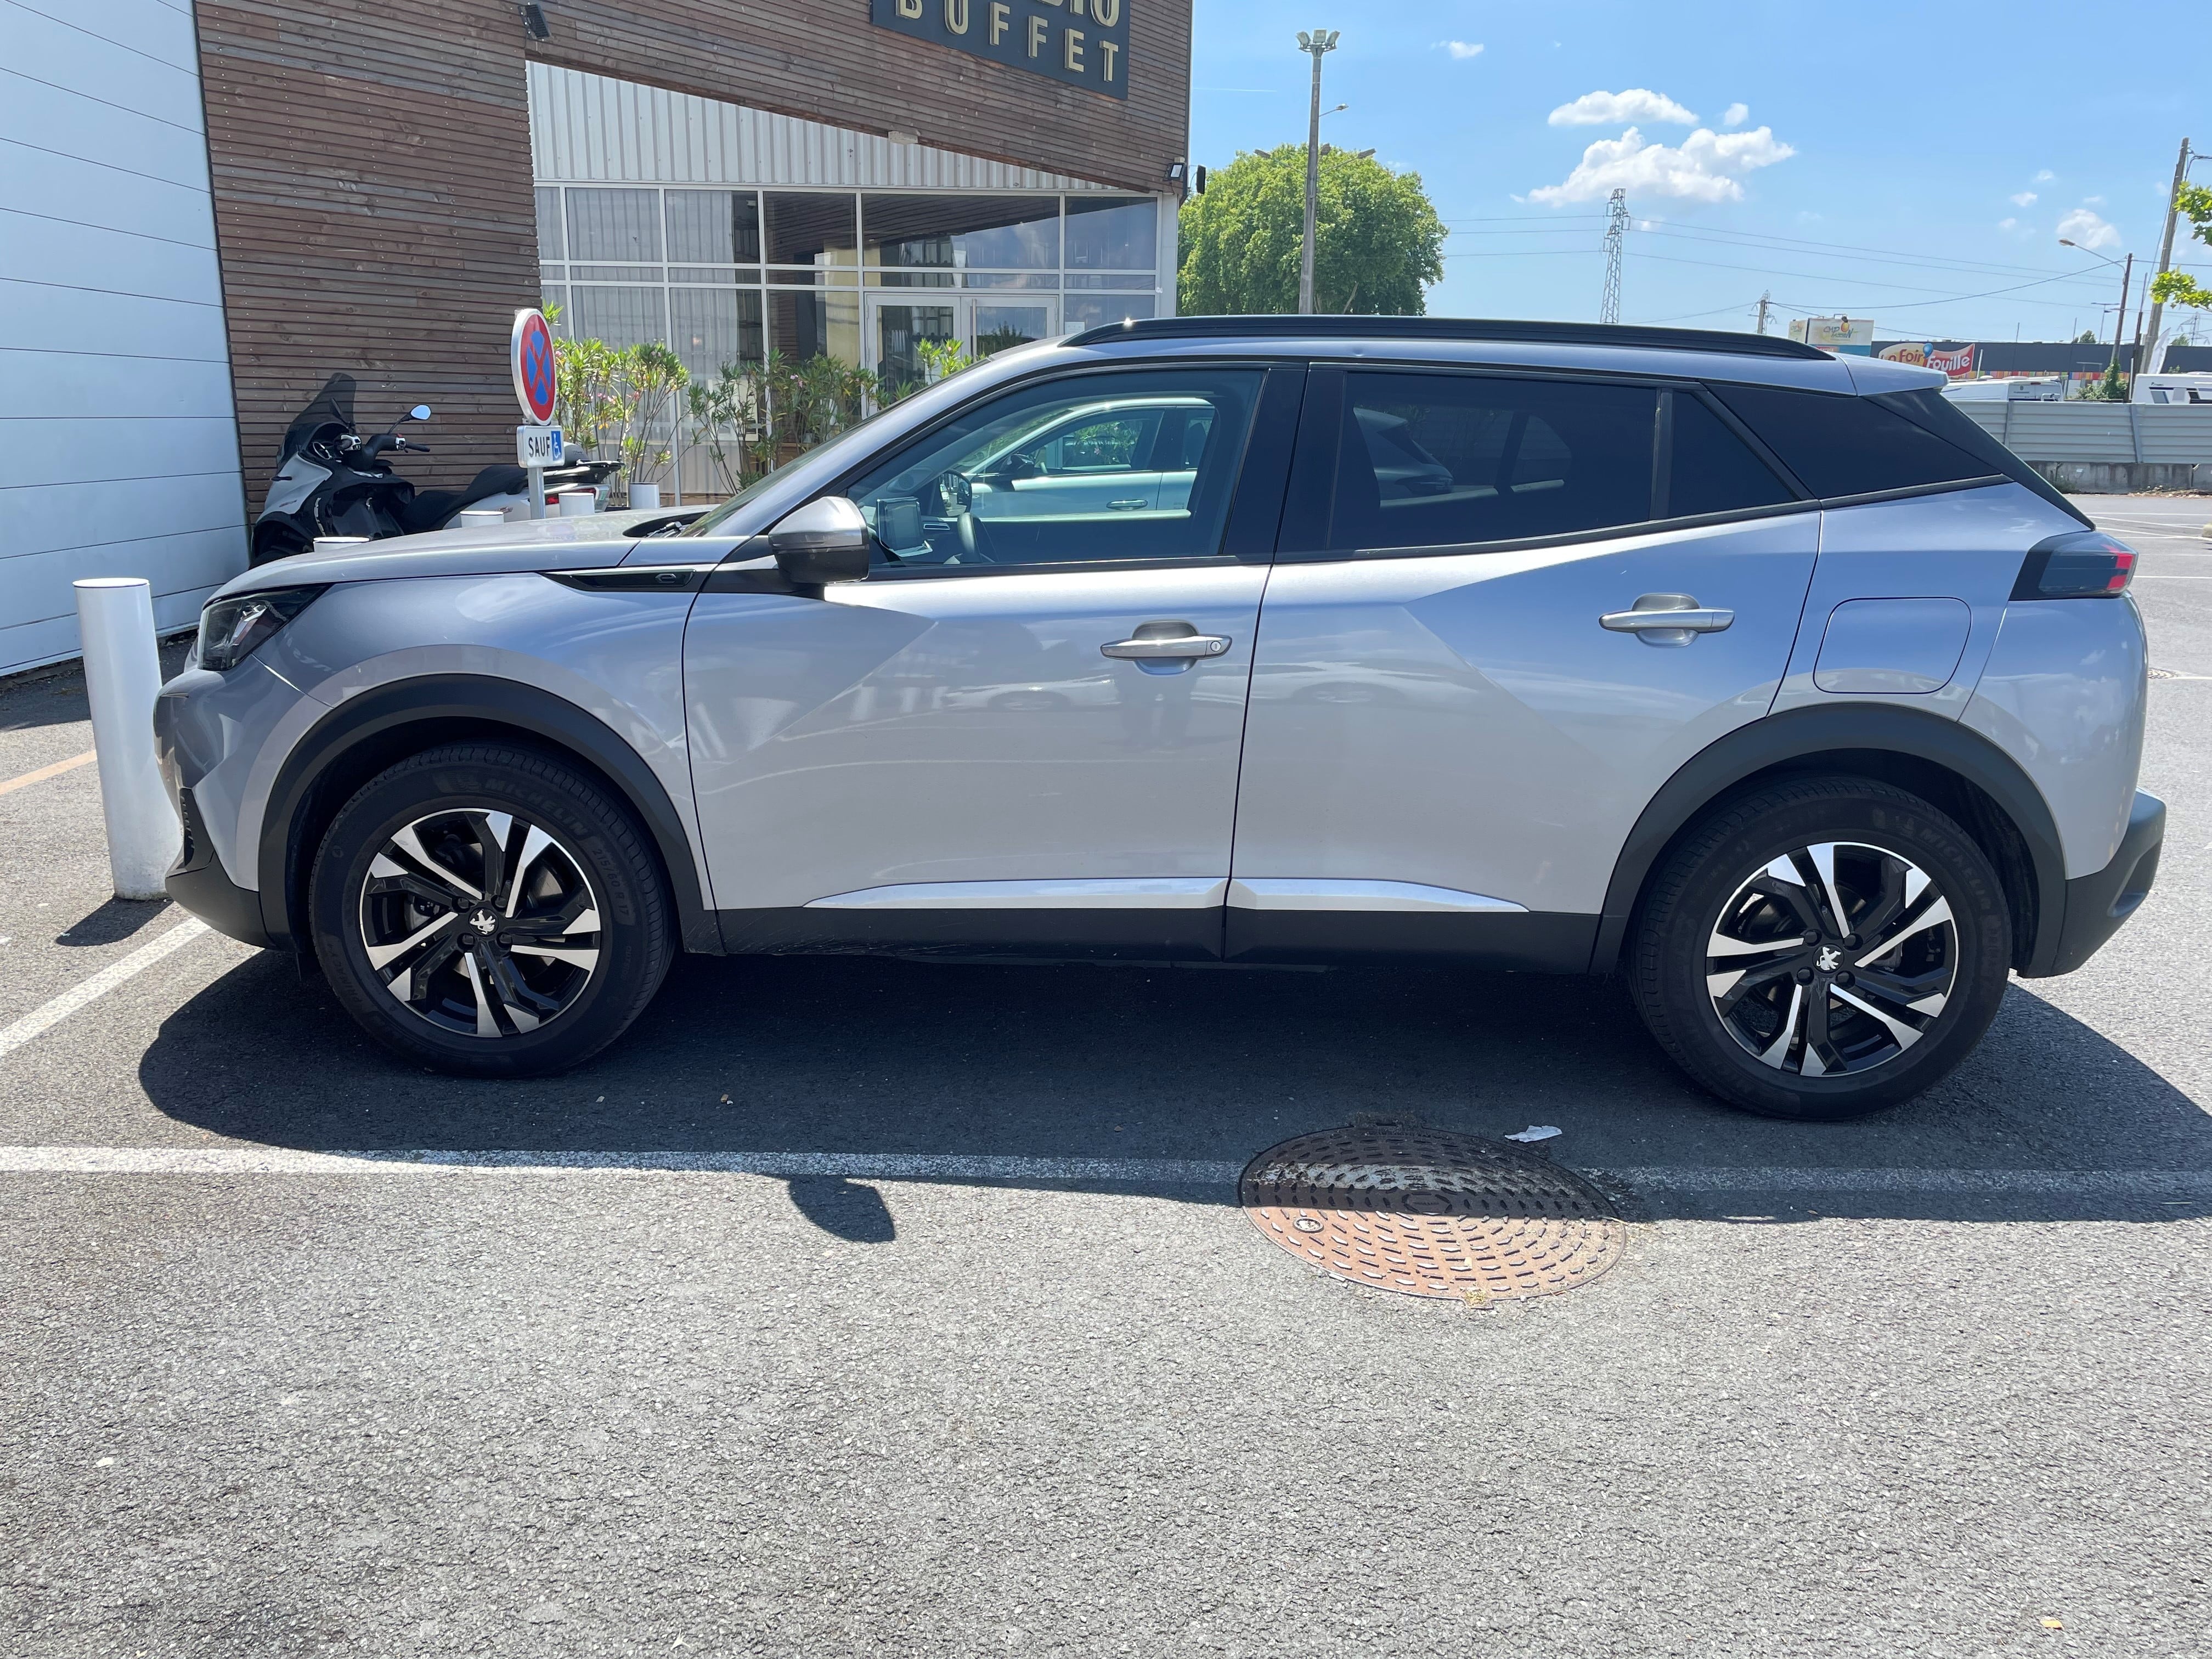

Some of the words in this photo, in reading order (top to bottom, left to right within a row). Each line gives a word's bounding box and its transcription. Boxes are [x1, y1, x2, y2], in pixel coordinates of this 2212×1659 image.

[1926, 355, 1970, 371] Fouille
[528, 436, 550, 458] SAUF
[484, 777, 589, 835] MICHELIN
